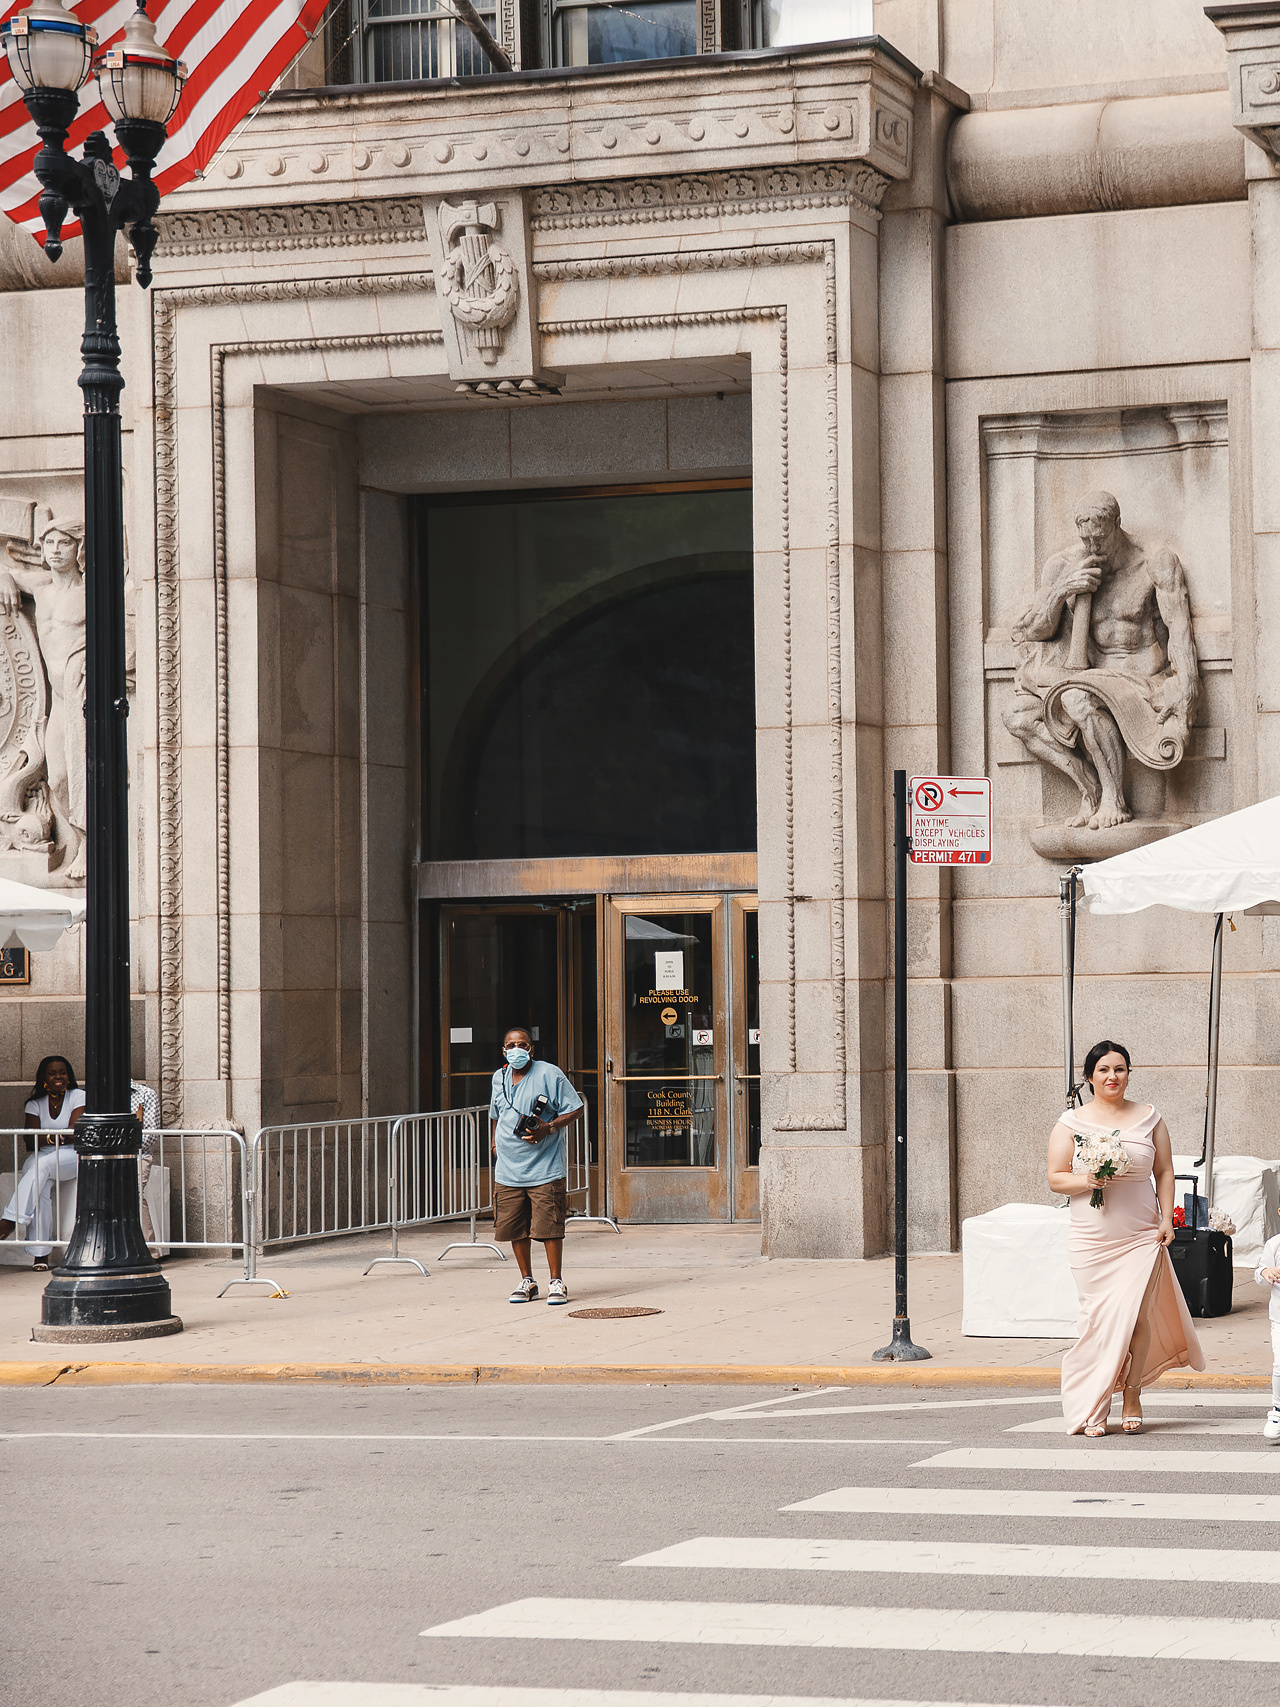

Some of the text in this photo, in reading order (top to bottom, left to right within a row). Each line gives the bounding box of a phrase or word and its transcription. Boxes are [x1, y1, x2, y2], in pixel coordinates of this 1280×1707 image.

[915, 819, 949, 827] ANYTIME
[915, 829, 985, 838] EXCEPT VEHICLES
[915, 839, 959, 847] DISPLAYING
[914, 851, 976, 863] PERMIT 471
[675, 988, 690, 996] USE
[639, 995, 699, 1004] REVOLVING DOOR
[647, 1091, 693, 1100] Cook County
[656, 1099, 685, 1108] Building
[649, 1108, 662, 1116] 118
[674, 1107, 693, 1115] Clark
